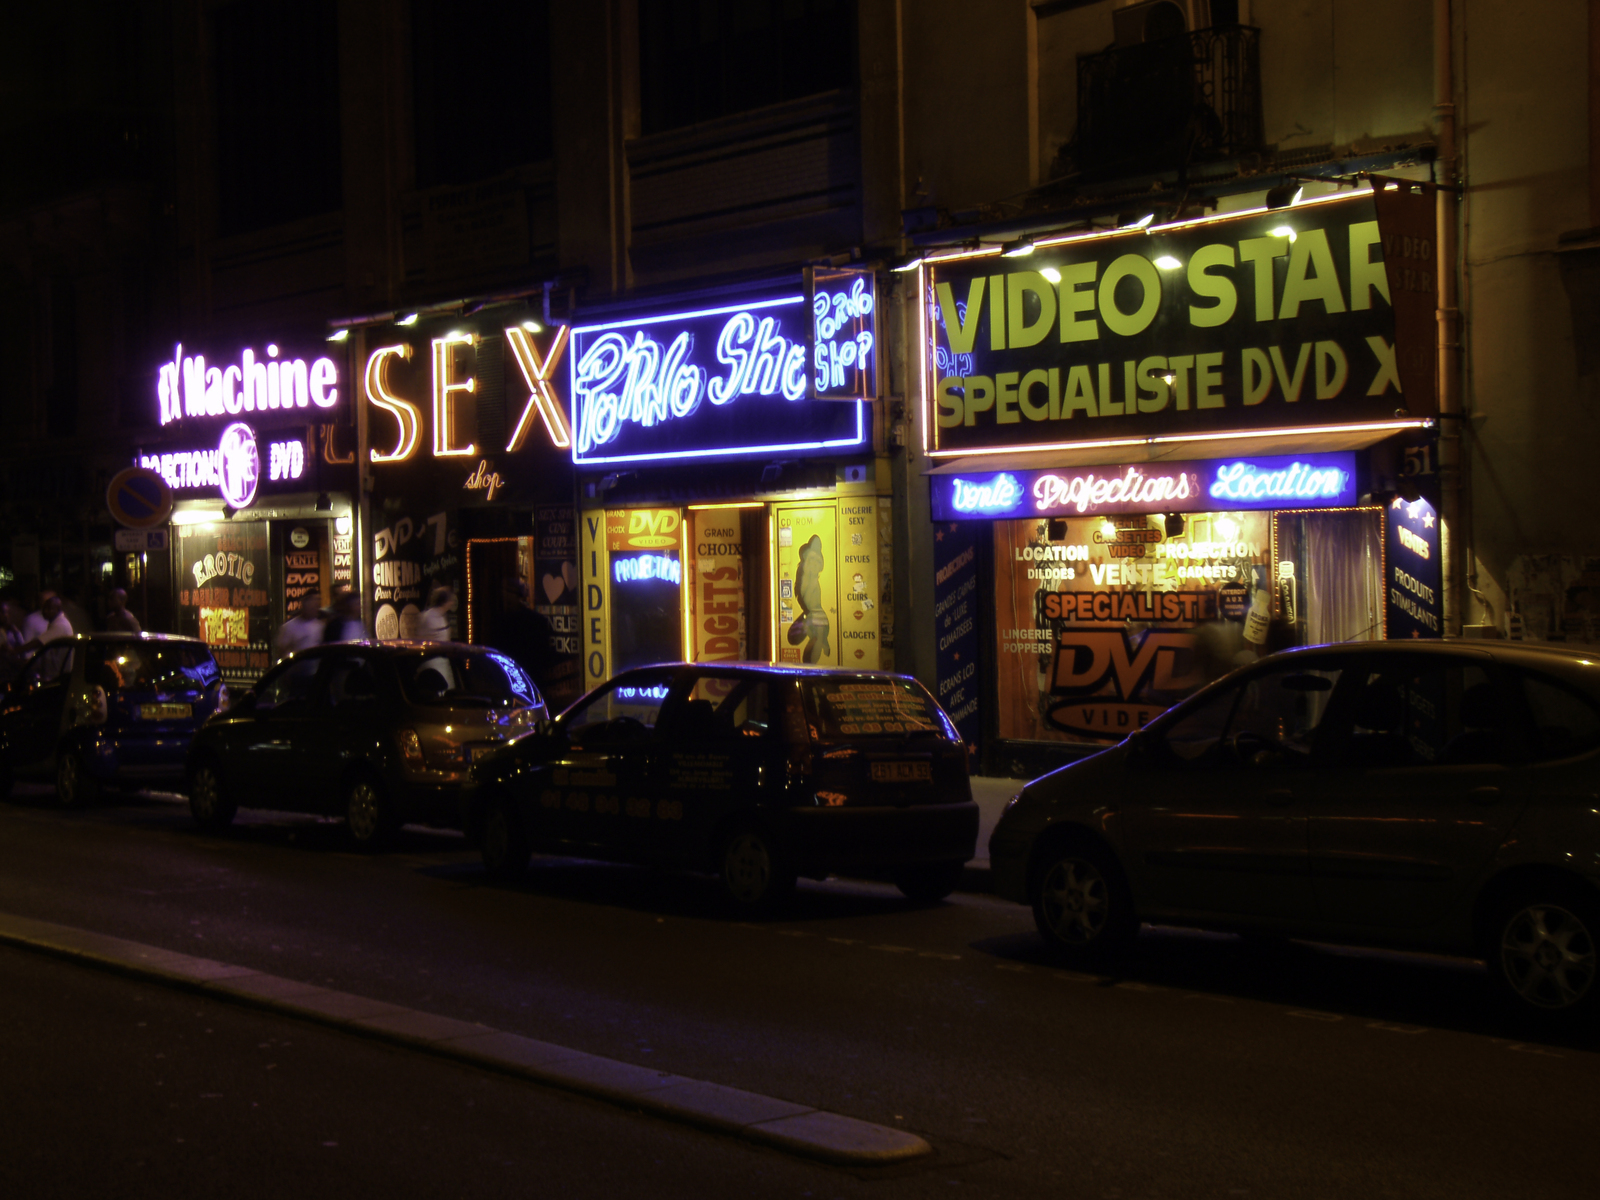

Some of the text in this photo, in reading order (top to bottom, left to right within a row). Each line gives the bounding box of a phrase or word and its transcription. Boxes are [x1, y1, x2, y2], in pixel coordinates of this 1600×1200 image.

[936, 253, 1162, 354] VIDEO
[184, 344, 338, 417] Machine
[937, 336, 1401, 428] SPECIALISTE DVD X
[365, 325, 570, 462] SEX
[270, 441, 304, 481] DVD
[1404, 445, 1434, 476] 51
[1034, 467, 1191, 512] Projections
[1210, 461, 1340, 498] Location
[606, 509, 625, 518] GRAND
[841, 506, 872, 515] LINGERIE
[606, 526, 625, 534] CHOIX
[628, 510, 680, 537] DVD
[781, 518, 814, 527] CD ROM
[849, 517, 865, 525] SEXY
[374, 516, 414, 560] DVD
[704, 528, 735, 538] GRAND
[1397, 525, 1430, 559] VENTES
[697, 543, 742, 556] CHOIX
[1015, 545, 1089, 561] LOCATION
[1108, 544, 1146, 558] VIDEO
[1156, 541, 1260, 559] PROJECTION
[845, 555, 870, 563] REVUES
[192, 551, 254, 588] EROTIC
[286, 572, 319, 585] DVD
[373, 561, 421, 588] CINEMA
[1028, 567, 1075, 580] DILDOES
[1089, 563, 1166, 585] VENTE
[1177, 565, 1237, 578] GADGETS
[1394, 567, 1434, 605] PRODUITS
[586, 516, 604, 679] VIDEO
[847, 593, 868, 601] CUIRS
[1391, 588, 1438, 632] STIMULANTS
[843, 631, 875, 640] GADGETS
[1003, 628, 1053, 640] LINGERIE
[1003, 643, 1053, 654] POPPERS
[963, 662, 975, 680] LCD
[950, 687, 965, 708] AVEC
[1083, 708, 1149, 727] VIDE
